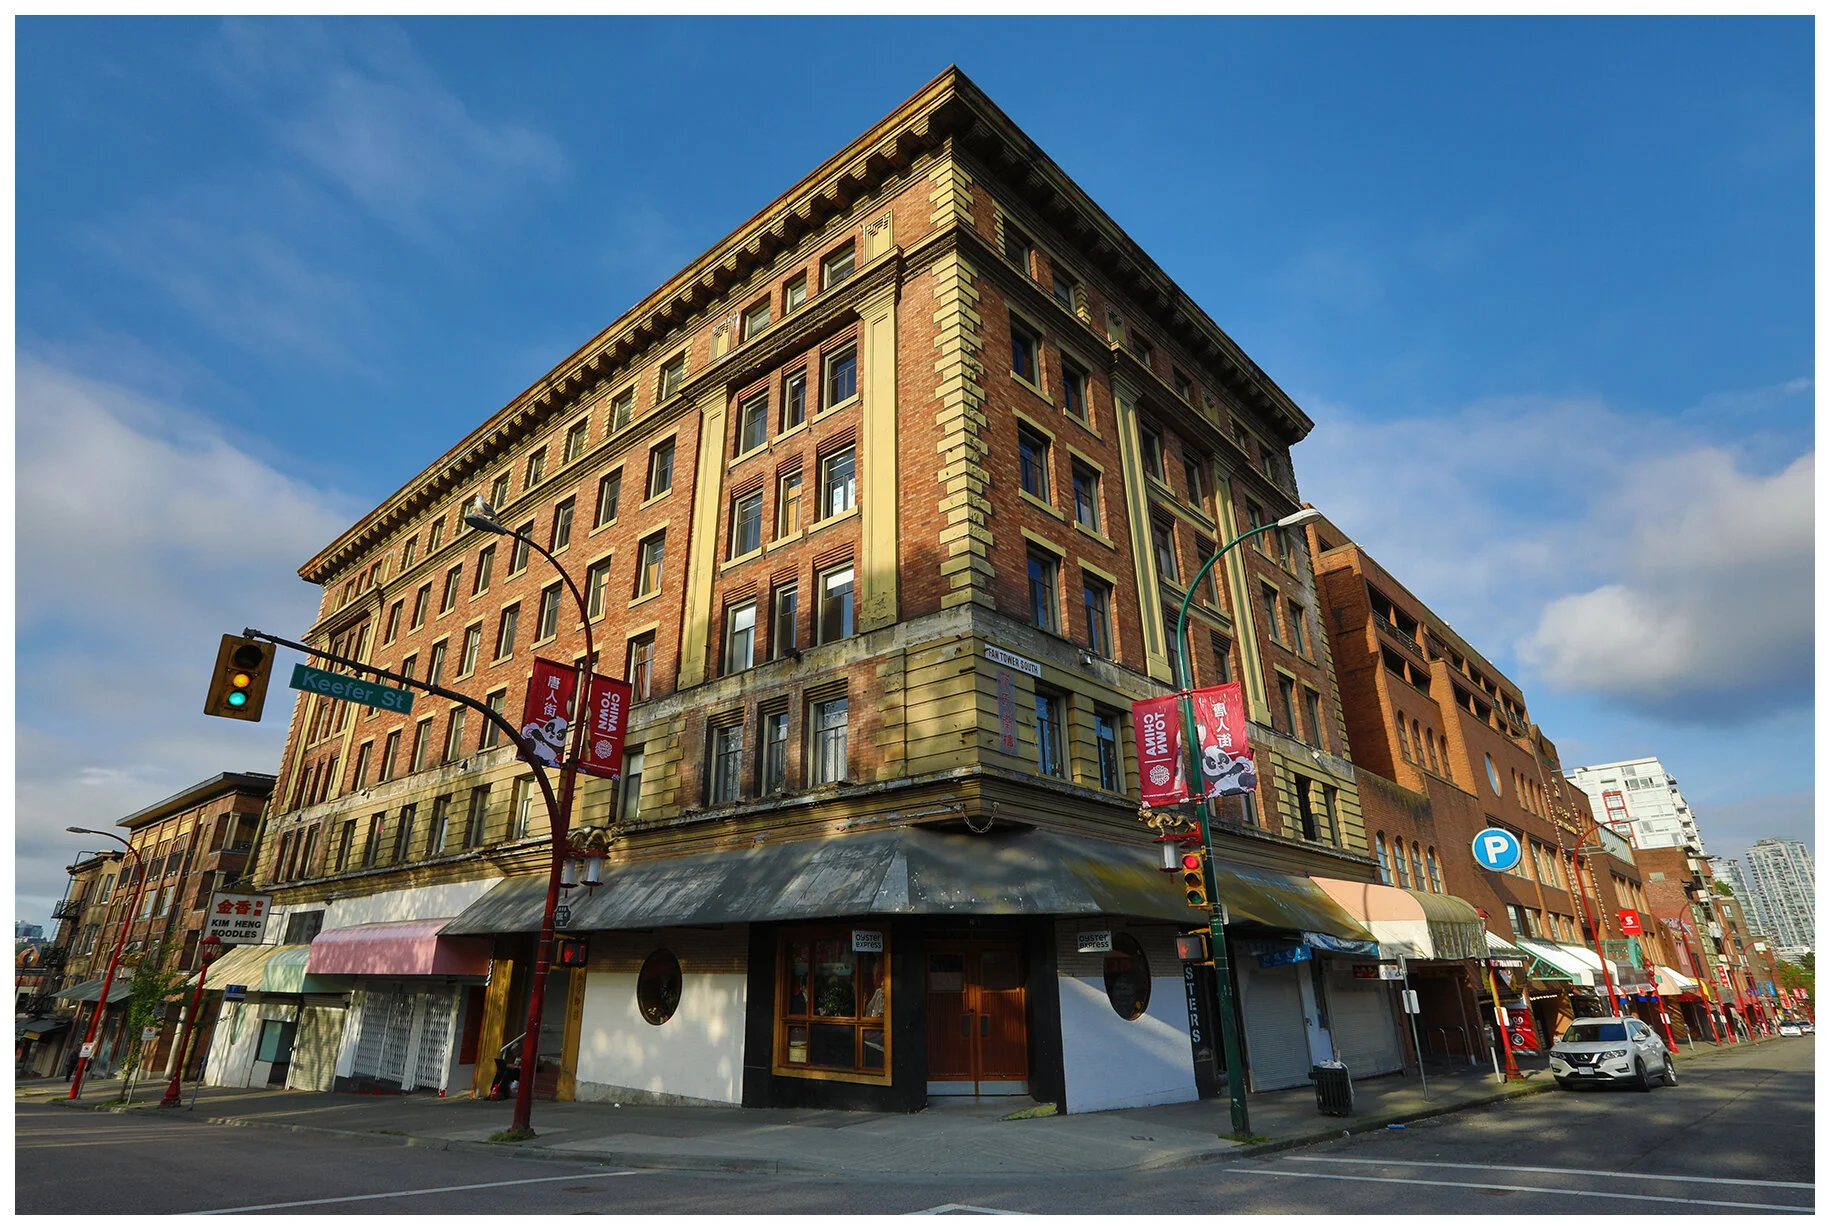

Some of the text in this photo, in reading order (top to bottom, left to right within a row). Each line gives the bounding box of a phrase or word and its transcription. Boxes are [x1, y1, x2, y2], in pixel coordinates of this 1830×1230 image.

[999, 652, 1020, 668] TOWER
[1020, 660, 1039, 674] SOUTH
[302, 671, 404, 709] Keefer St
[543, 675, 561, 718] 唐人街
[597, 691, 612, 730] TOWN
[607, 693, 621, 732] CHINA
[1483, 836, 1509, 864] P
[211, 919, 261, 929] KIM HENG
[1185, 966, 1201, 1043] STERS
